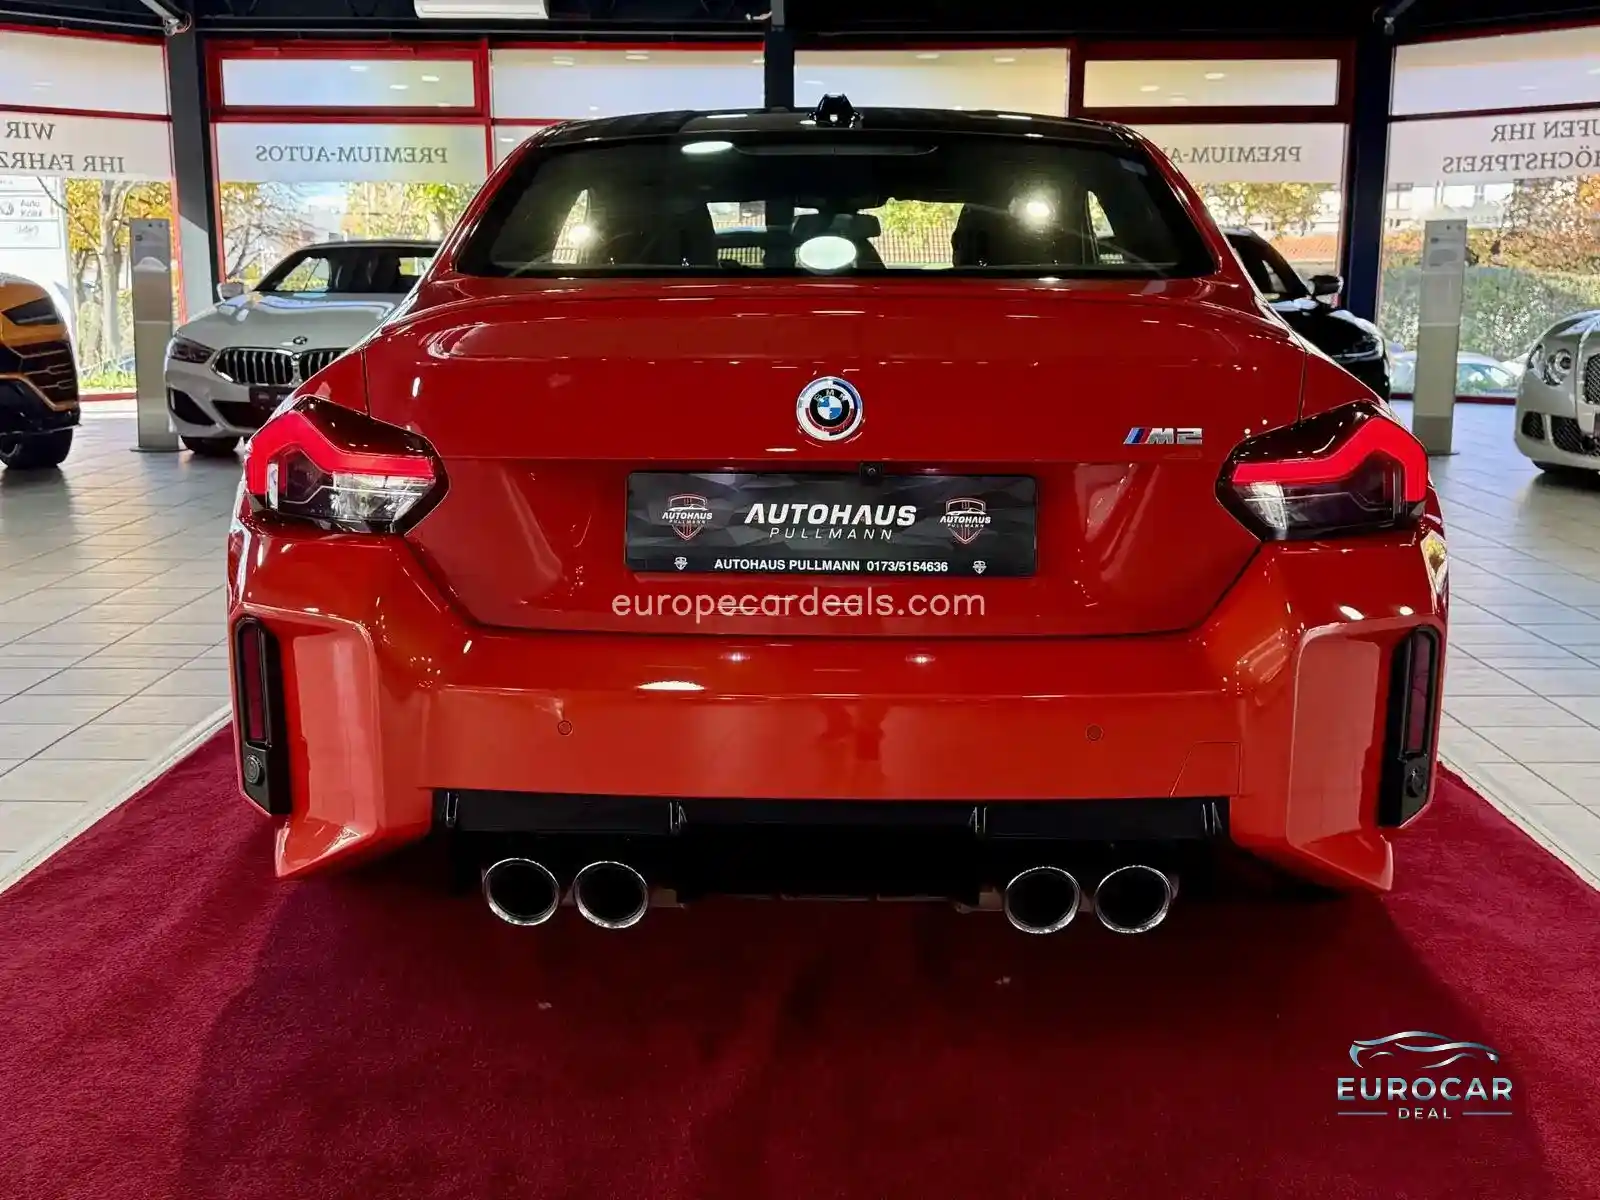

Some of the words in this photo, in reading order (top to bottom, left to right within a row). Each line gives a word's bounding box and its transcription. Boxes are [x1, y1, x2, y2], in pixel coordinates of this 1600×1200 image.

[1145, 427, 1203, 445] M2
[661, 512, 713, 520] AUTOHAUS
[744, 503, 917, 526] AUTOHAUS
[939, 515, 991, 524] AUTOHAUS
[769, 527, 892, 540] PULLMANN
[714, 558, 786, 571] AUTOHAUS
[789, 558, 860, 571] PULLMANN
[866, 560, 949, 572] 0173/5154636
